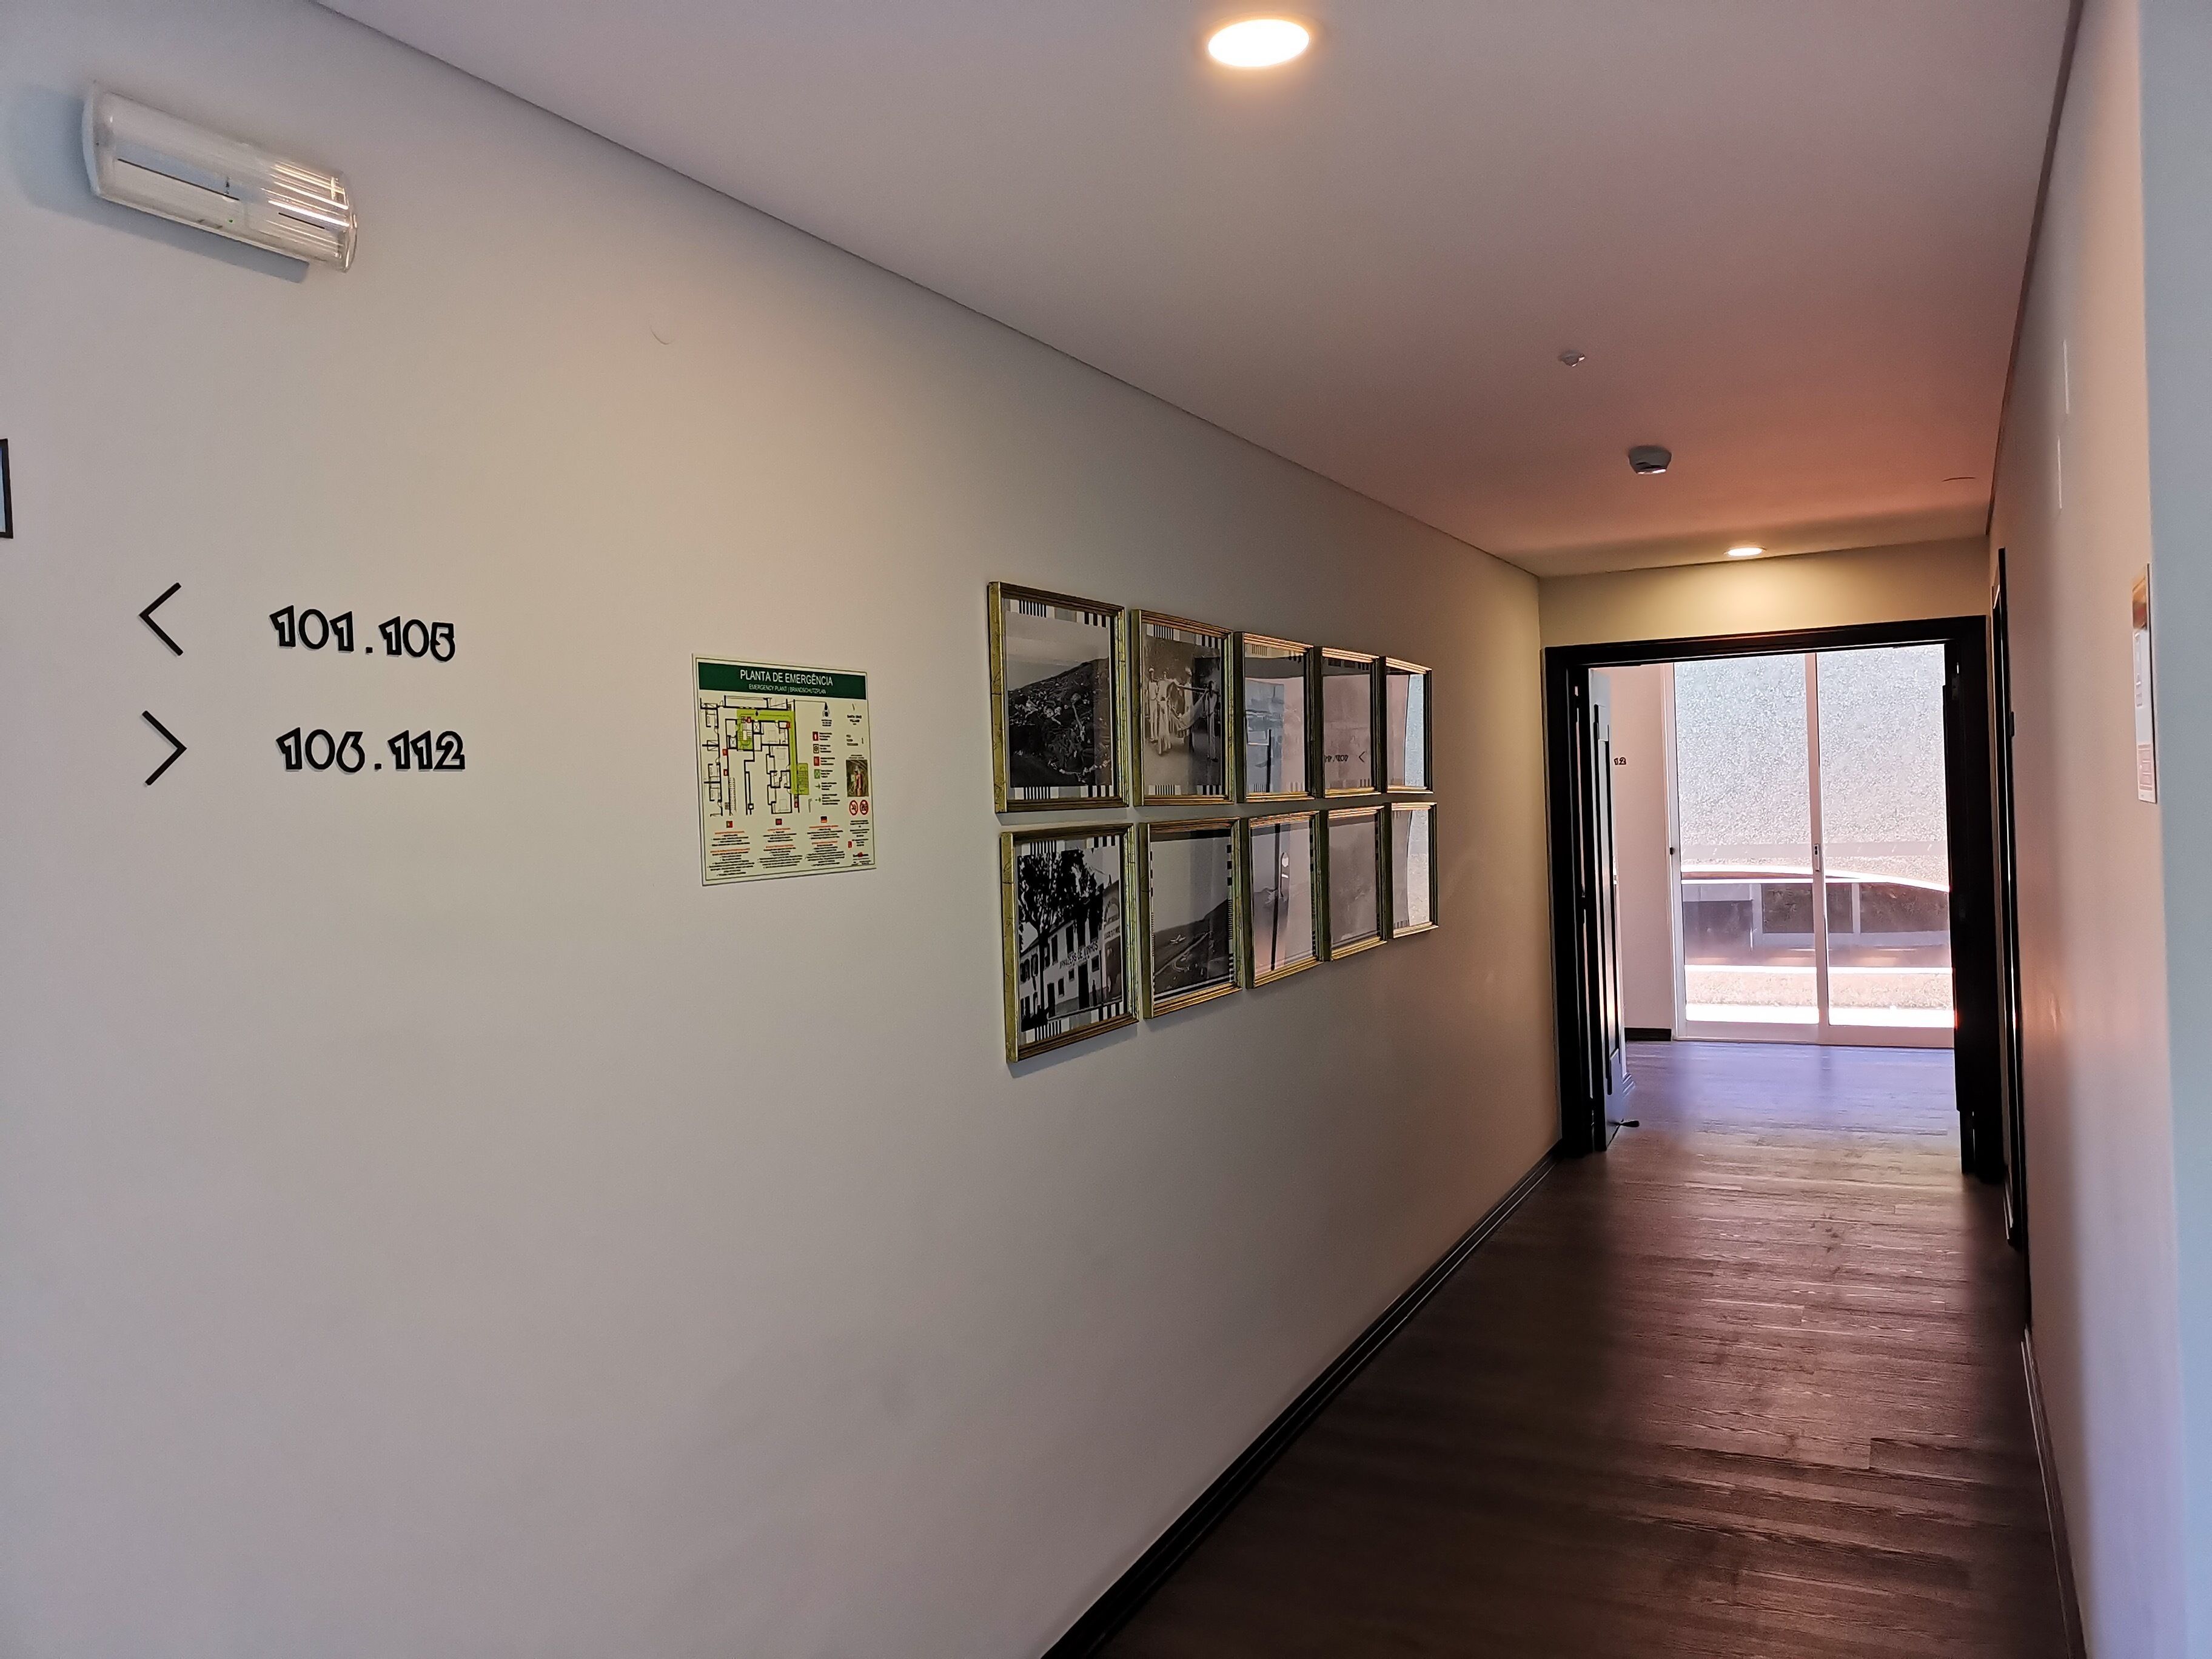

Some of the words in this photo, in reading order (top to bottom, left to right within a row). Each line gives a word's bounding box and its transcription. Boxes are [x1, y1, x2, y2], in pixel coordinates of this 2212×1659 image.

[740, 669, 771, 682] PLANTA
[773, 672, 784, 683] DE
[785, 673, 833, 686] EMERGÊNCIA
